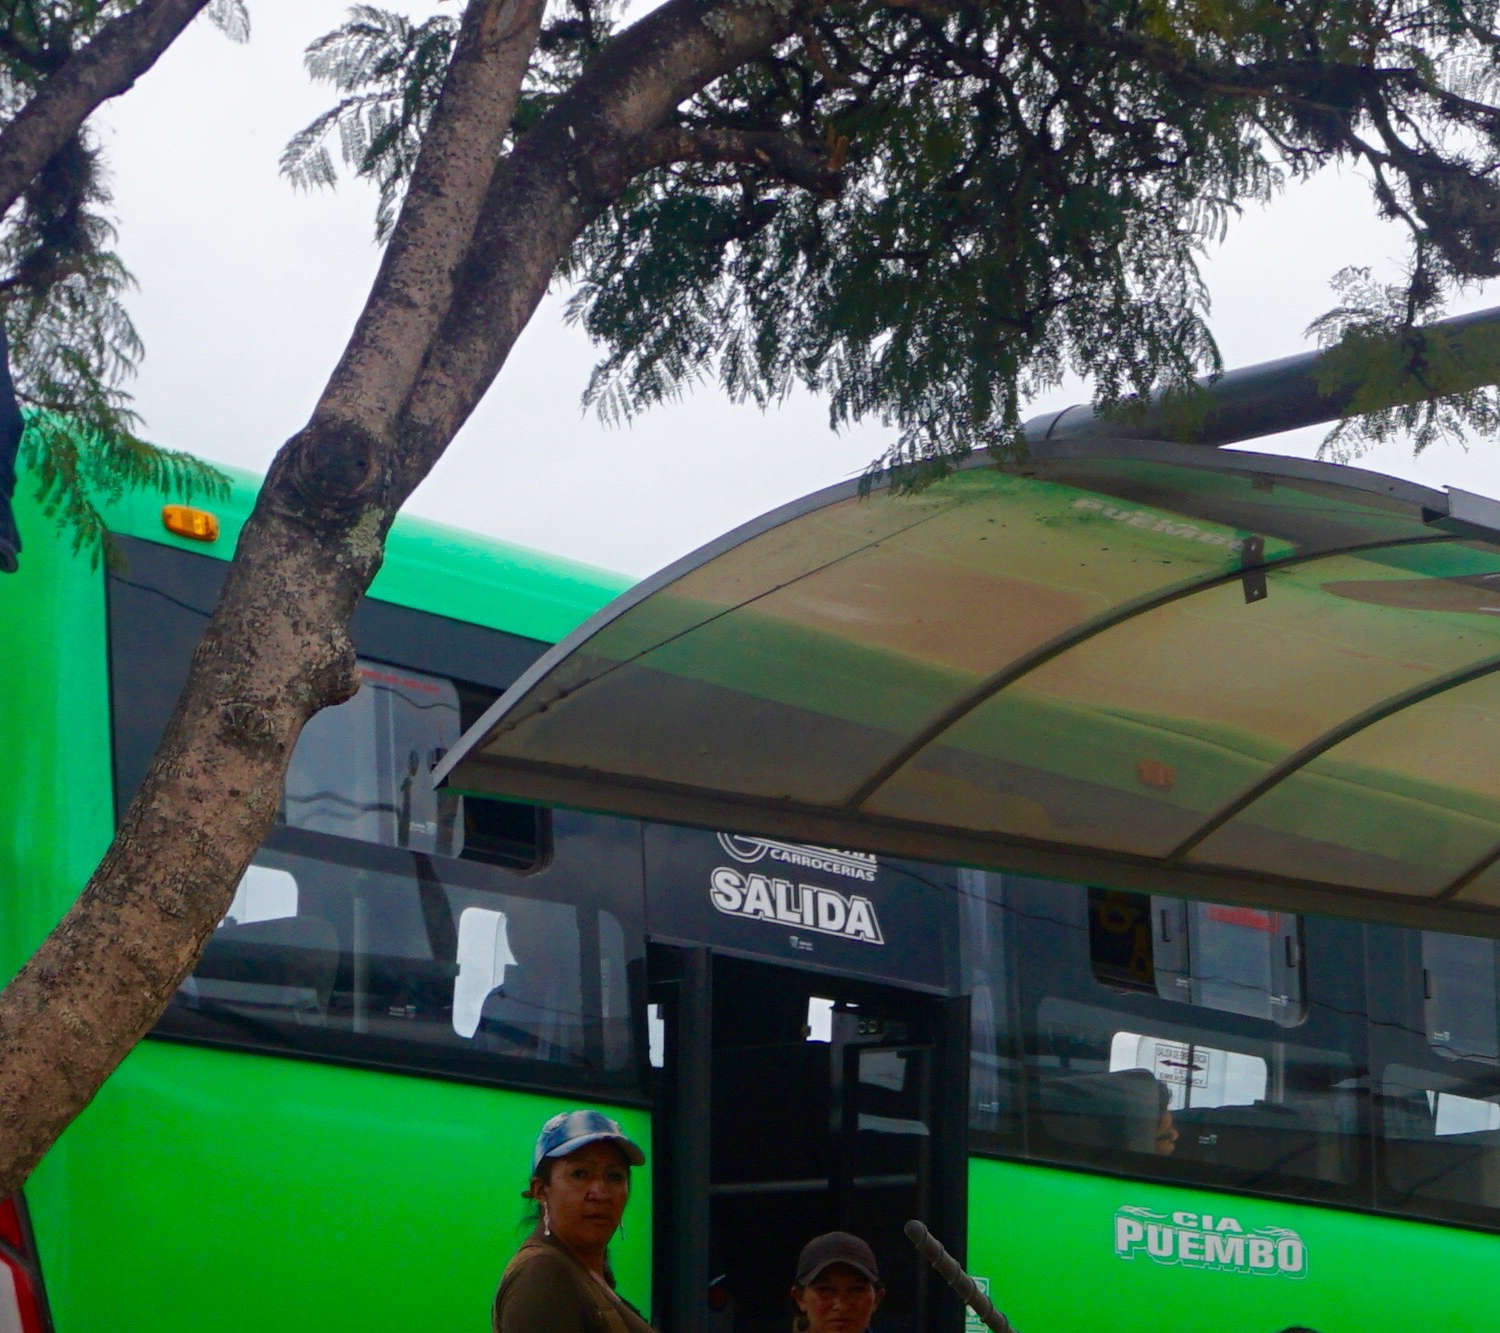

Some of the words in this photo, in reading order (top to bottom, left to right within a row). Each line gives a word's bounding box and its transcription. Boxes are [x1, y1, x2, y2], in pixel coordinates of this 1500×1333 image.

[770, 848, 875, 882] CARROCERIAS
[712, 868, 880, 943] SALIDA
[1114, 1211, 1305, 1274] PUEMBO
[1172, 1211, 1243, 1232] CIA
